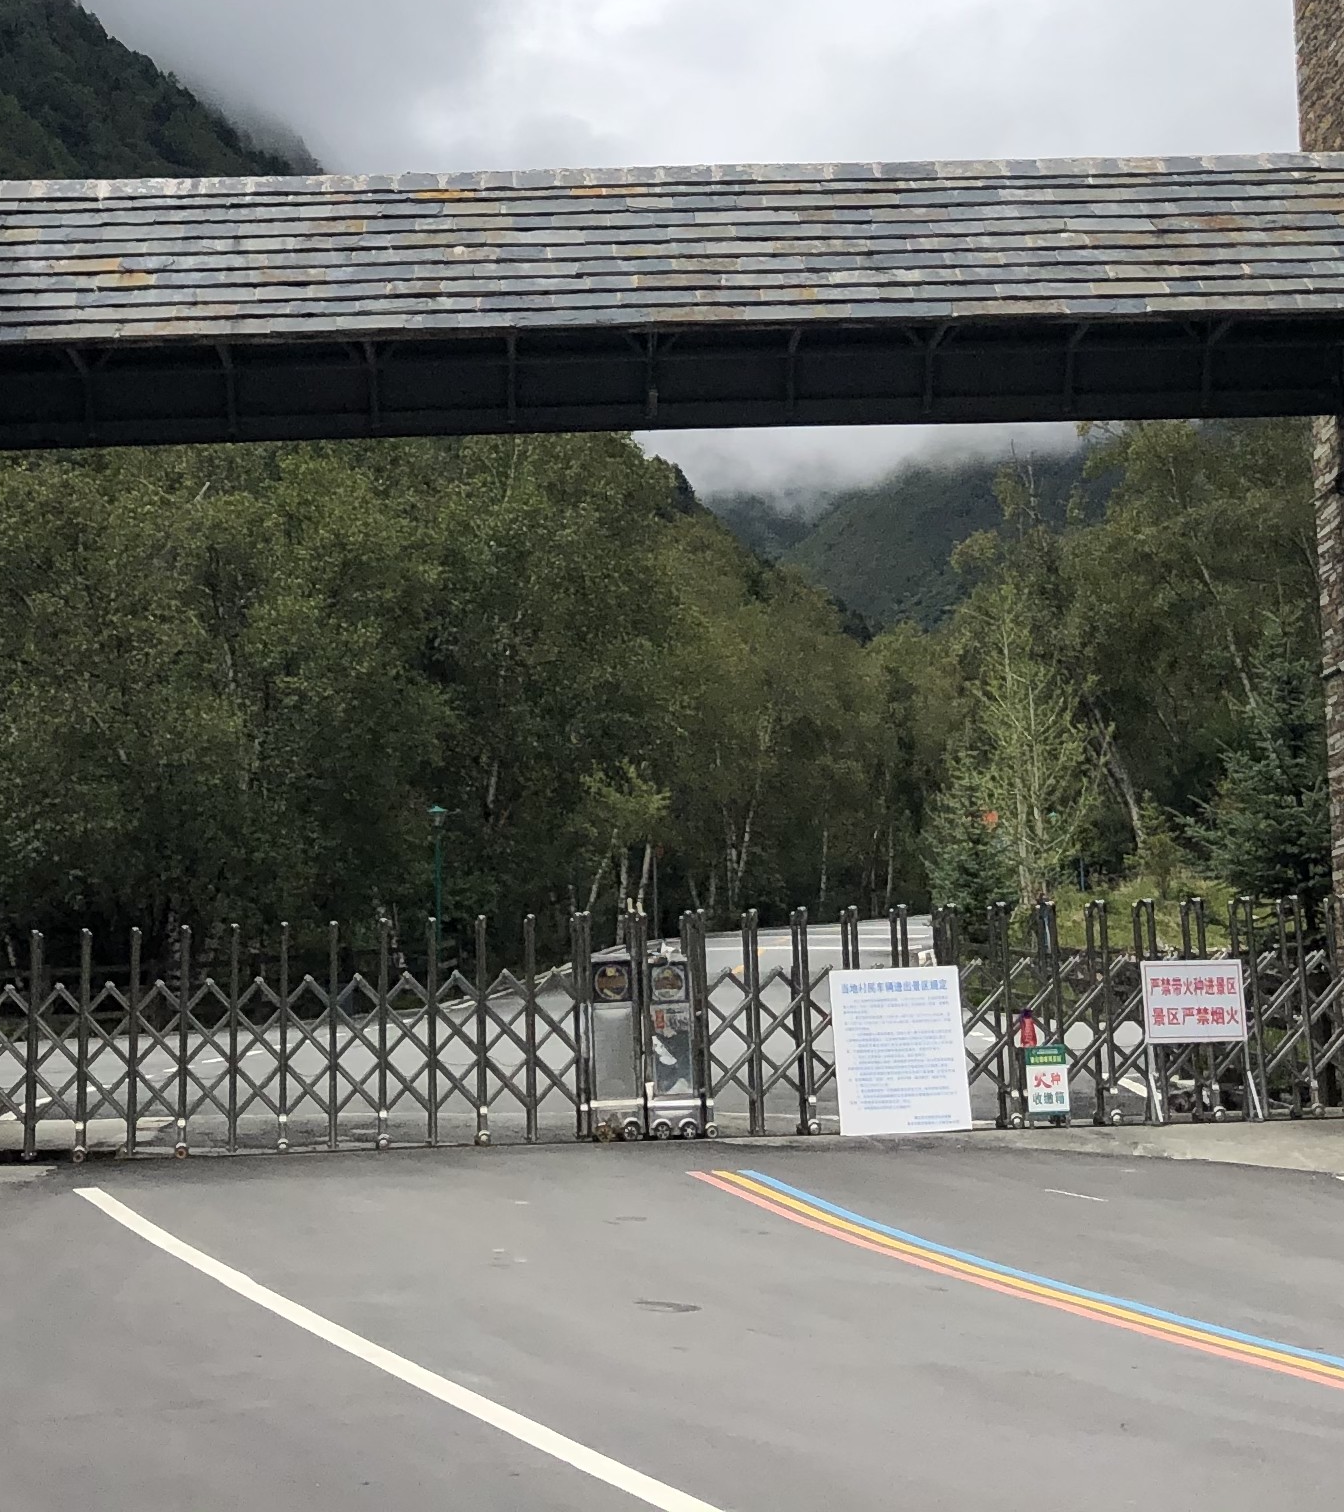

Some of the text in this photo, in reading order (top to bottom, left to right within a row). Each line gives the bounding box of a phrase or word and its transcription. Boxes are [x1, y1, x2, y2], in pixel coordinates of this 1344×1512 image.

[1150, 976, 1237, 996] 严禁带火种进景区
[1152, 1006, 1239, 1026] 景区严禁烟火
